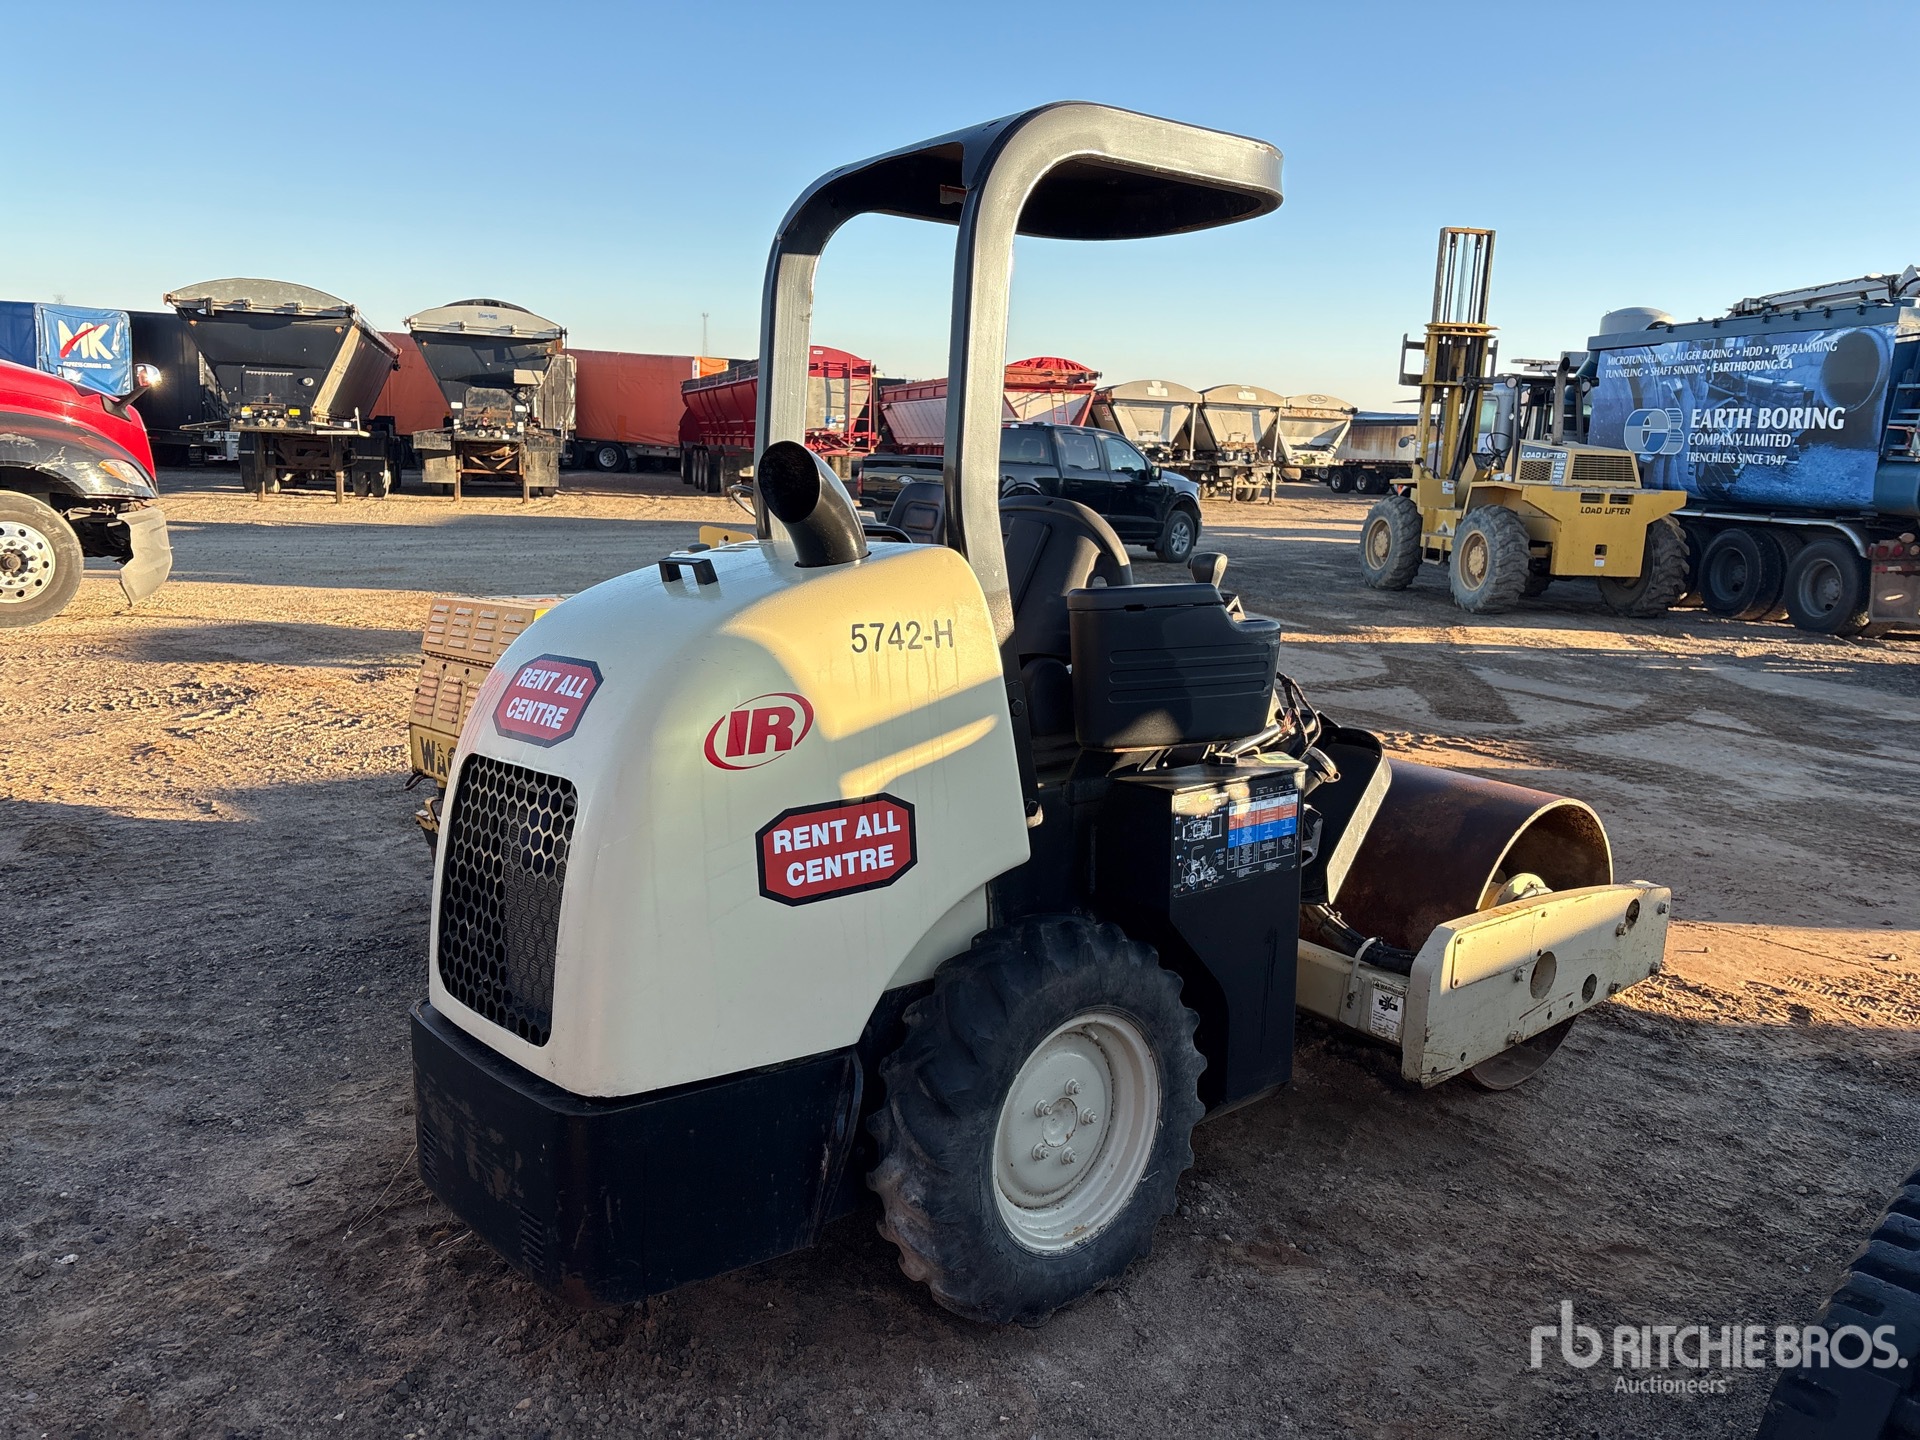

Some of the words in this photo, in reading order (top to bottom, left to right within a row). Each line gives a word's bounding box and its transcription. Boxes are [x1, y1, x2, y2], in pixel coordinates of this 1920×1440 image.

[58, 320, 113, 360] MK
[1607, 353, 1668, 366] MICROTUNNELING
[1676, 351, 1700, 361] AUGER
[1702, 348, 1734, 360] BORING
[1742, 346, 1763, 357] HDD
[1771, 344, 1791, 355] PIPE
[1791, 341, 1838, 353] RAMMING
[1605, 368, 1643, 379] TUNNELING
[1650, 365, 1672, 376] SHAFT
[1673, 364, 1705, 375] SINKING
[1713, 359, 1793, 373] EARTHBORING.CA
[1690, 408, 1751, 429] EARTH
[1757, 407, 1845, 430] BORING
[1687, 432, 1741, 446] COMPANY
[1744, 433, 1791, 447] LIMITED
[1521, 451, 1541, 459] LOAD
[1686, 452, 1735, 464] TRENCHLESS
[1737, 453, 1764, 465] SINCE
[1766, 454, 1787, 466] 1947
[1581, 506, 1602, 514] LOAD
[1605, 507, 1631, 515] LIFTER
[851, 619, 954, 653] 5742-H
[516, 667, 561, 692] RENT
[554, 674, 588, 699] ALL
[506, 697, 569, 730] CENTRE
[725, 705, 796, 758] IR
[773, 819, 847, 854] RENT
[855, 810, 901, 839] ALL
[786, 844, 895, 887] CENTRE
